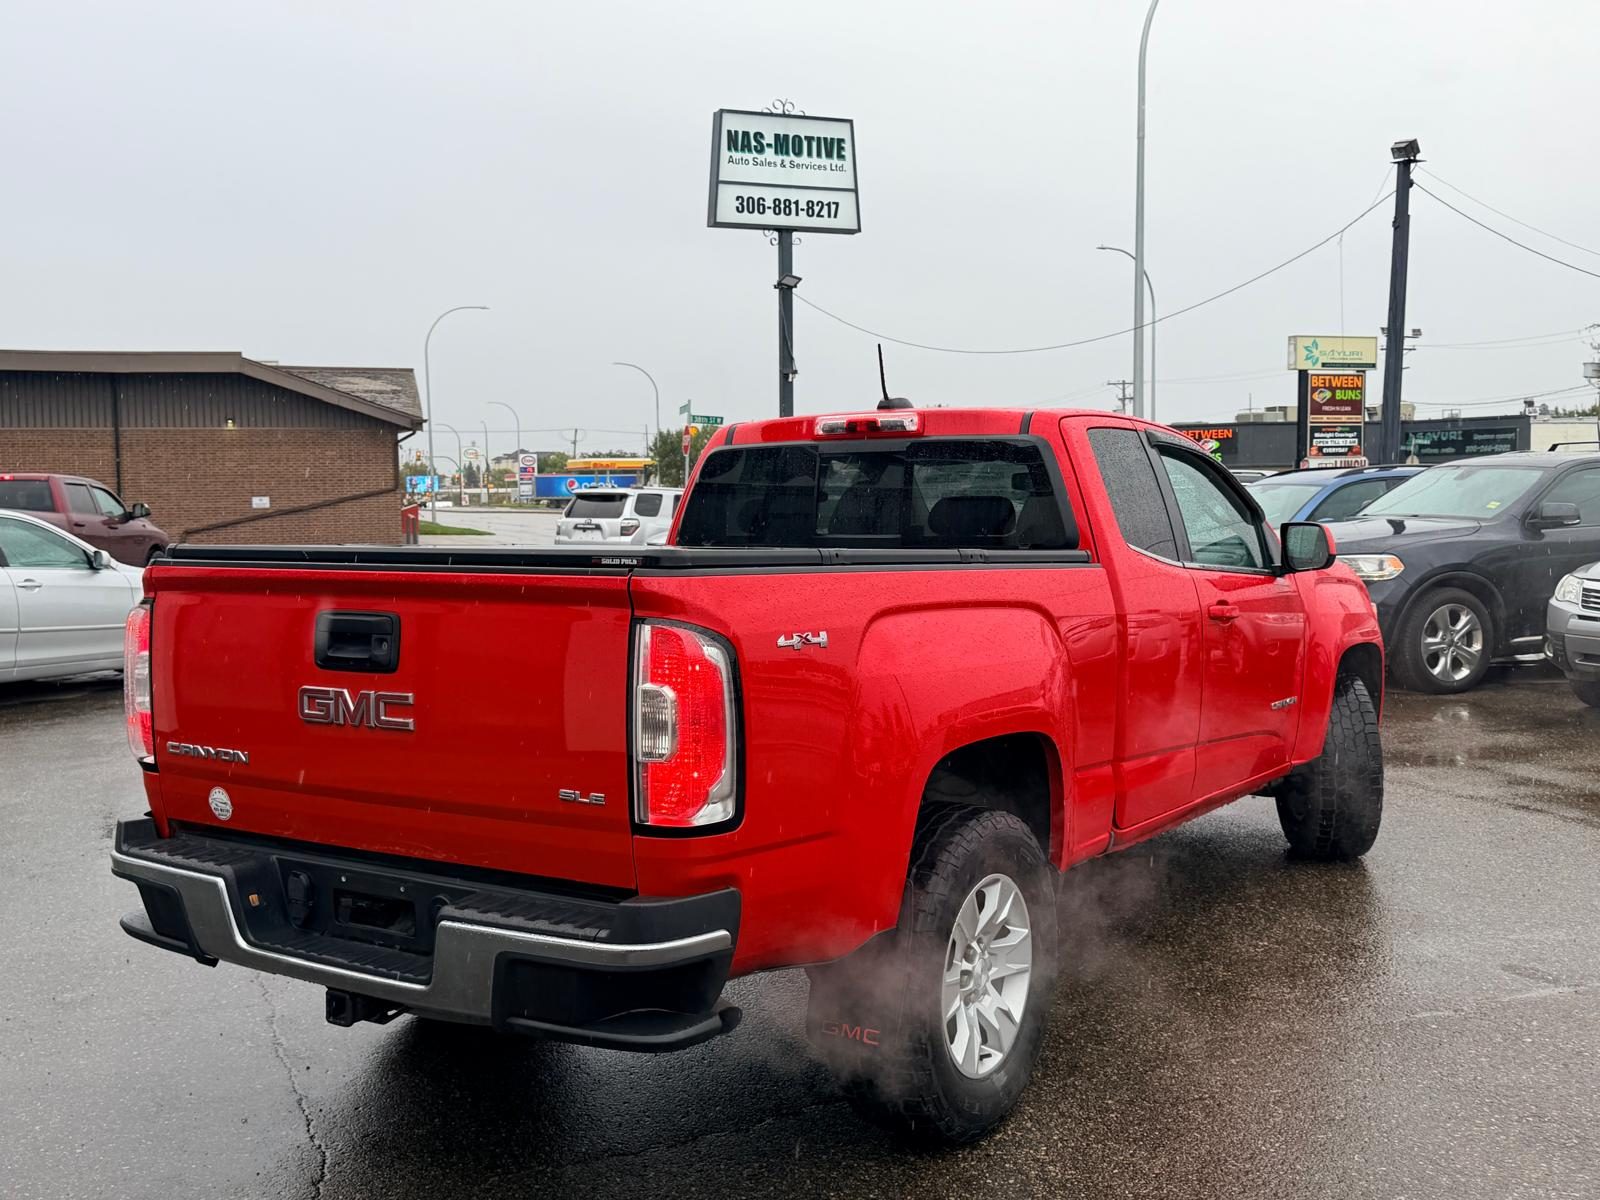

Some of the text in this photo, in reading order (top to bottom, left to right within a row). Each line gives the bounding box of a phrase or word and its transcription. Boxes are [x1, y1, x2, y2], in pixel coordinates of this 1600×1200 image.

[727, 129, 846, 161] NAS-MOTIVE
[727, 155, 847, 172] Auto Sales & Services Ltd.
[735, 195, 840, 219] 306-881-8217
[1311, 375, 1362, 388] BETWEEN
[1335, 389, 1361, 400] BUNS
[299, 684, 416, 731] GMC
[166, 741, 249, 764] CANYON
[559, 788, 606, 805] SLE
[821, 1020, 881, 1046] GMC
